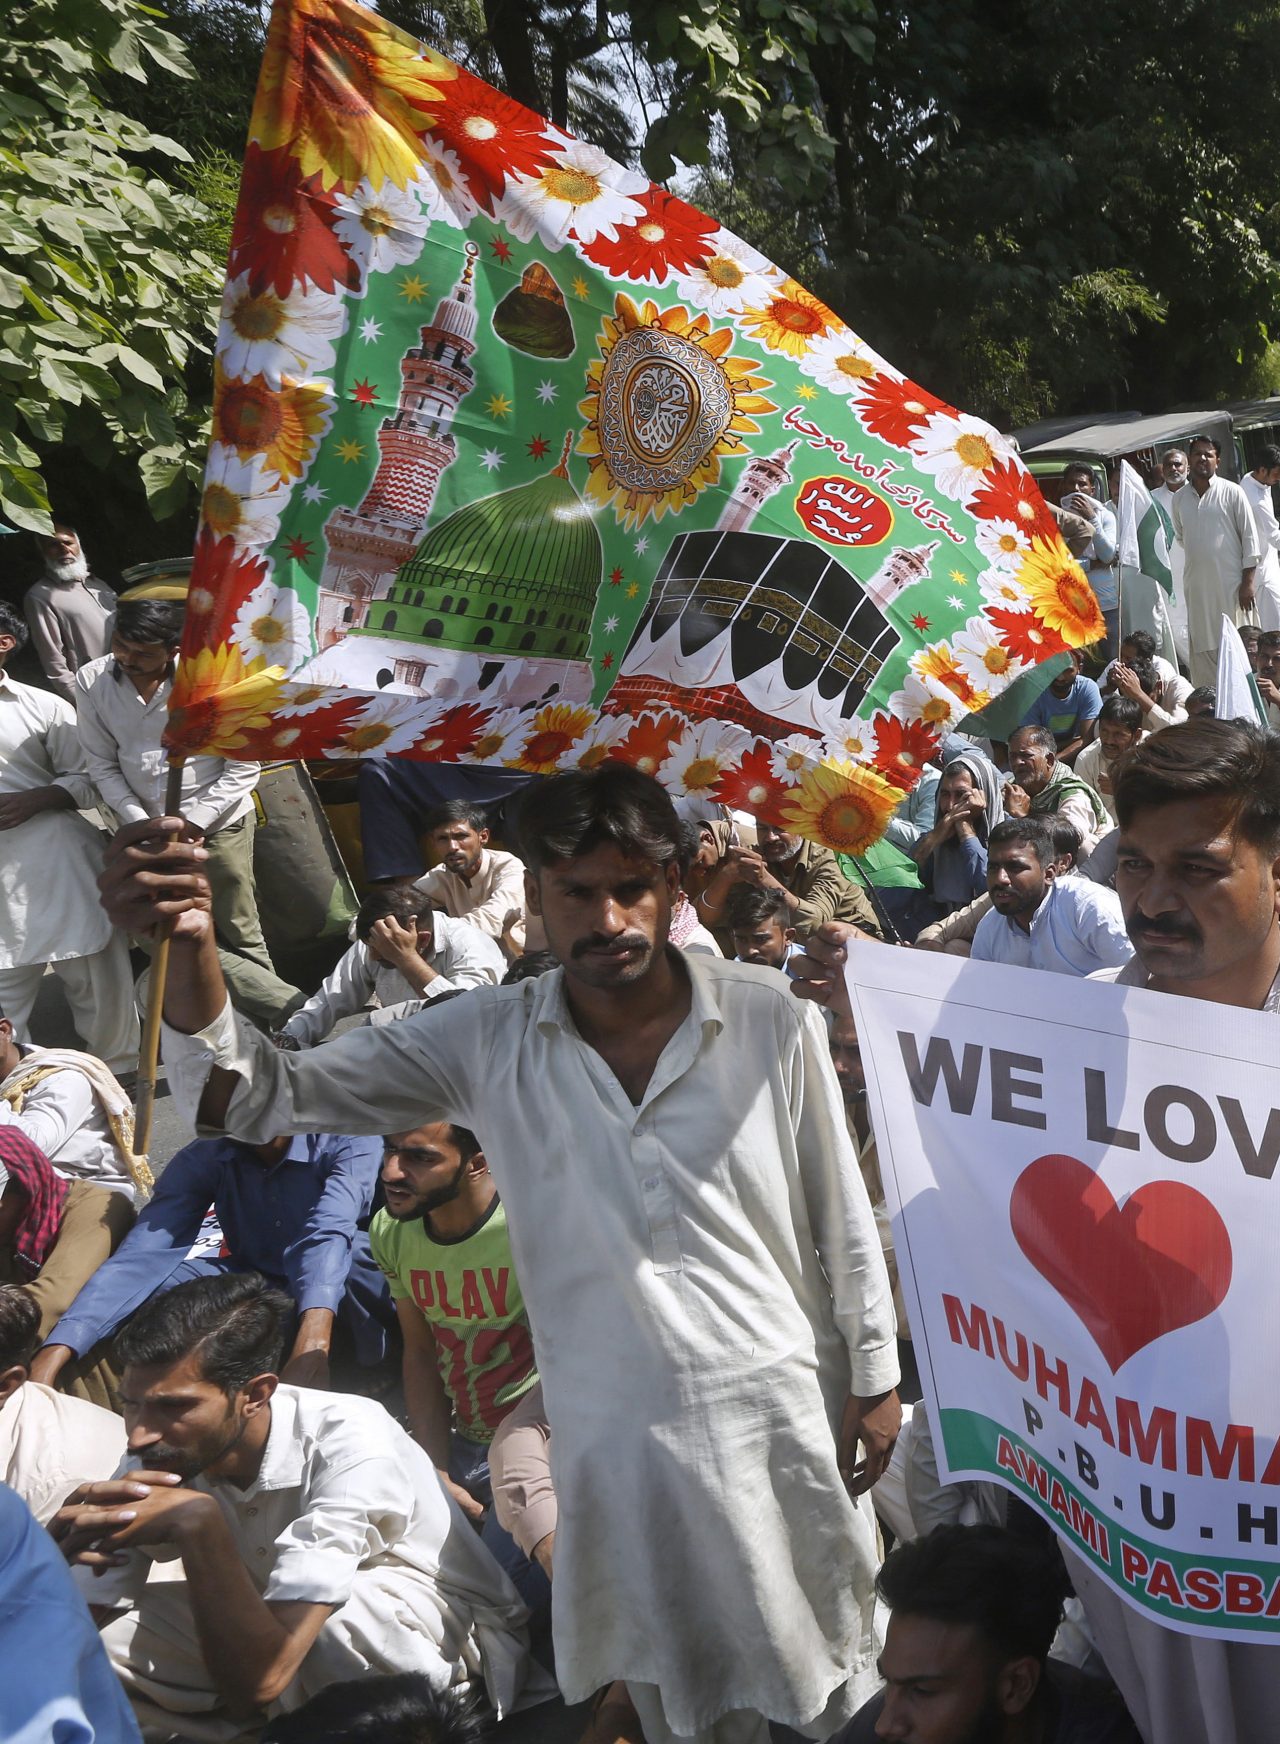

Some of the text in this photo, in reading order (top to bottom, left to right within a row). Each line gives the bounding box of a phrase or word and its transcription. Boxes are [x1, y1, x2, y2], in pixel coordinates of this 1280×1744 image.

[785, 406, 845, 453] مرحبا
[839, 455, 900, 482] آمد
[896, 1031, 1047, 1131] WE
[409, 1267, 510, 1320] PLAY
[996, 1436, 1112, 1566] AWAMI
